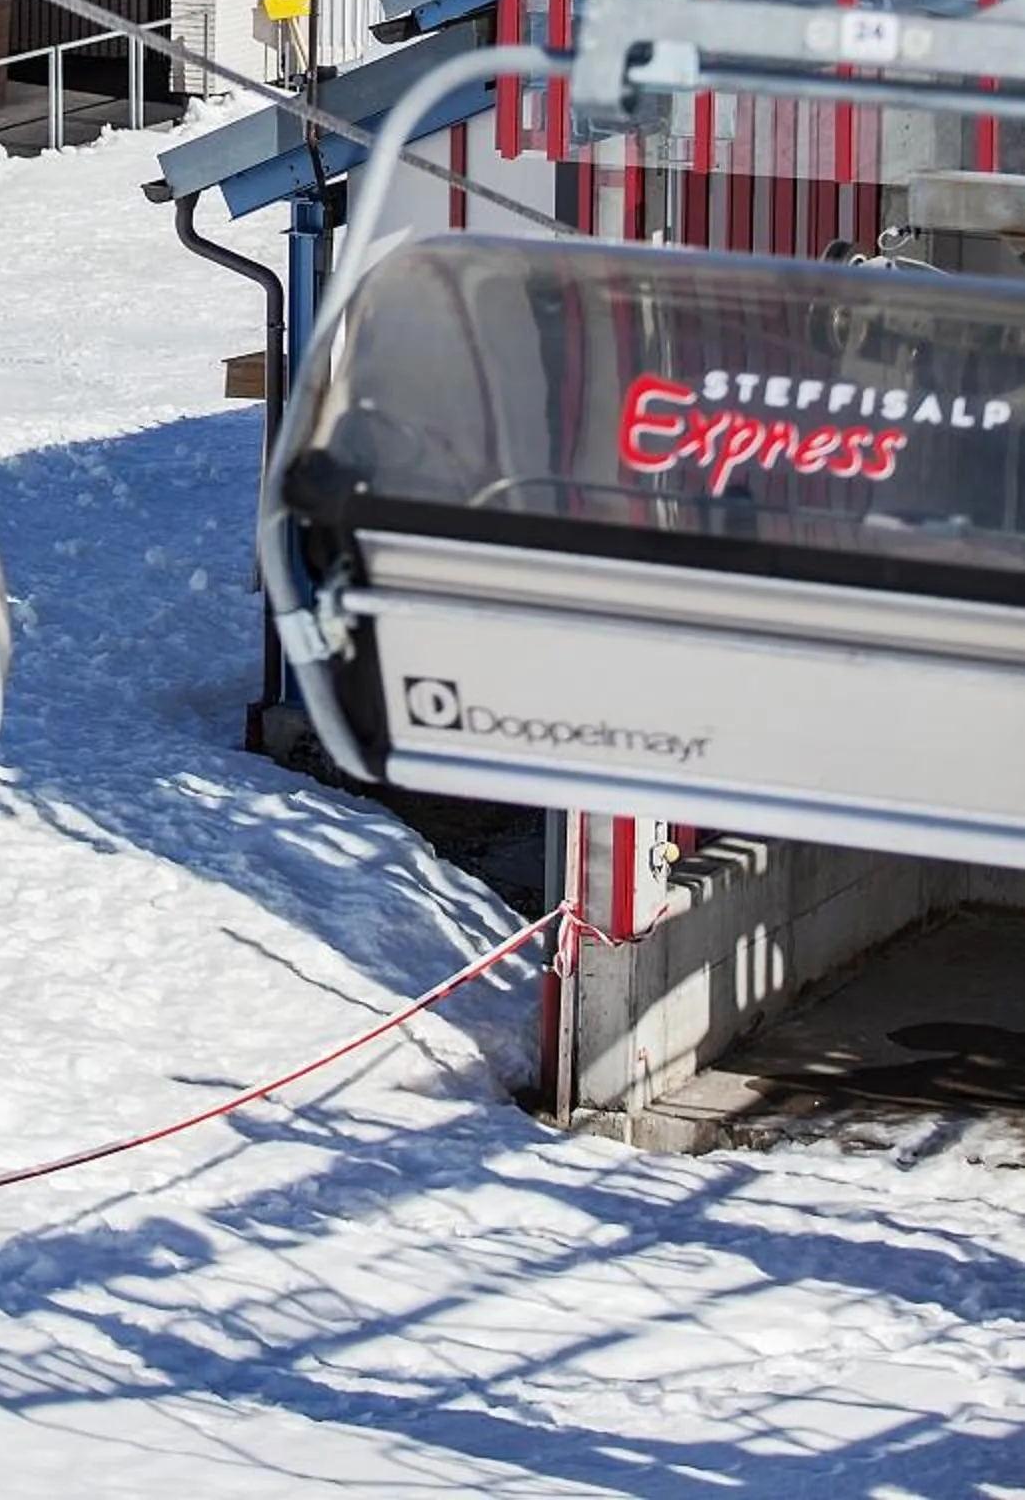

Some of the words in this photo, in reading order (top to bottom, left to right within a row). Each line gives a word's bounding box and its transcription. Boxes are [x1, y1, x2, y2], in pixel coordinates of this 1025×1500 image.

[702, 369, 1013, 430] STEFFISALP
[619, 372, 907, 497] Express
[466, 705, 711, 762] Doppelmayr
